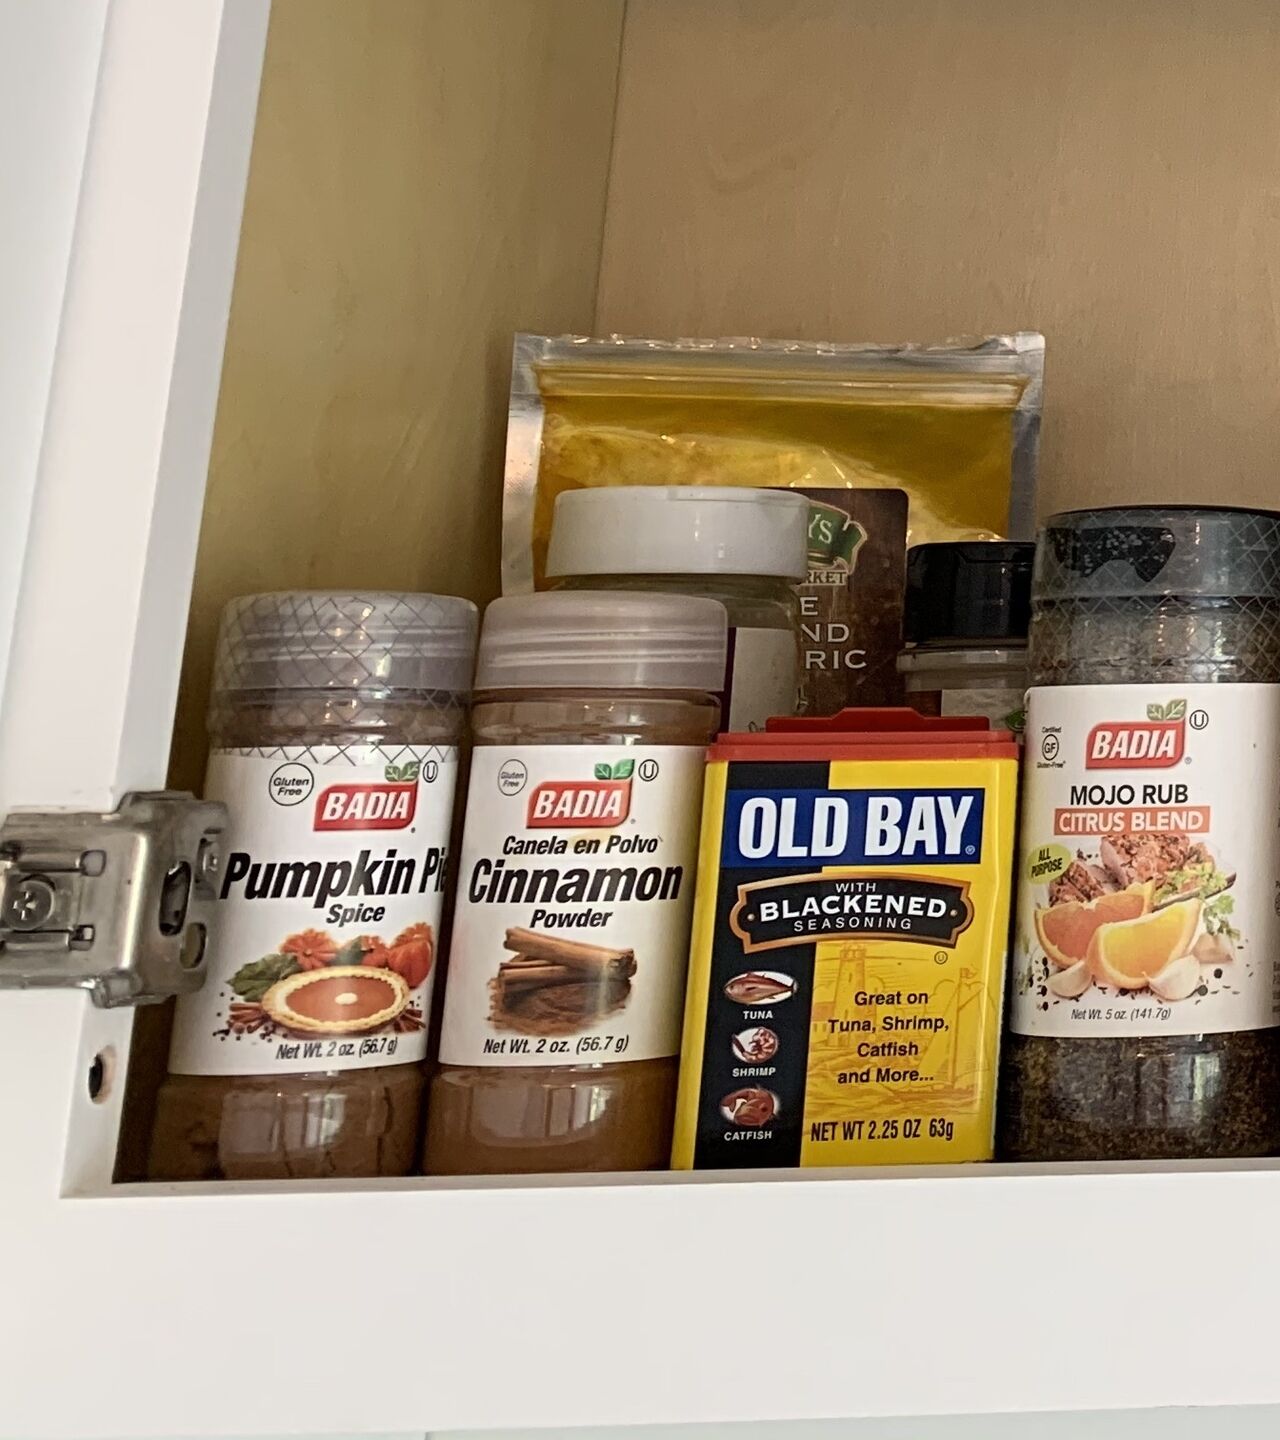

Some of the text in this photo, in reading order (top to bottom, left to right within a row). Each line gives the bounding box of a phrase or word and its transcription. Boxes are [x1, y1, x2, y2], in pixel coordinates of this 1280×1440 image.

[1092, 730, 1177, 759] BADIA
[273, 777, 309, 787] Gluten
[277, 788, 302, 796] Free
[1070, 784, 1188, 805] MOJO RUB
[322, 792, 411, 821] BADIA
[533, 790, 623, 818] BADIA
[739, 796, 974, 859] OLD BAY
[1059, 812, 1203, 832] CITRUS BLEND
[503, 835, 658, 855] Canela en Polvo
[1038, 849, 1050, 861] ALL
[1031, 858, 1063, 877] PURPOSE
[219, 849, 416, 909] Pumpkin
[469, 858, 683, 903] Cinnamon
[835, 882, 876, 893] WITH
[326, 902, 385, 927] Spice
[760, 895, 946, 922] BLACKENED
[530, 908, 612, 929] Powder
[794, 917, 912, 932] SEASONING
[855, 992, 928, 1006] Great on
[743, 1010, 773, 1020] TUNA
[828, 1016, 949, 1033] Tuna, Shrimp,
[857, 1042, 918, 1057] Catfish
[732, 1067, 776, 1077] SHRIMP
[838, 1068, 934, 1084] and More...
[724, 1131, 772, 1141] CATFISH
[811, 1118, 954, 1142] NET WT 2.25 OZ 63g
